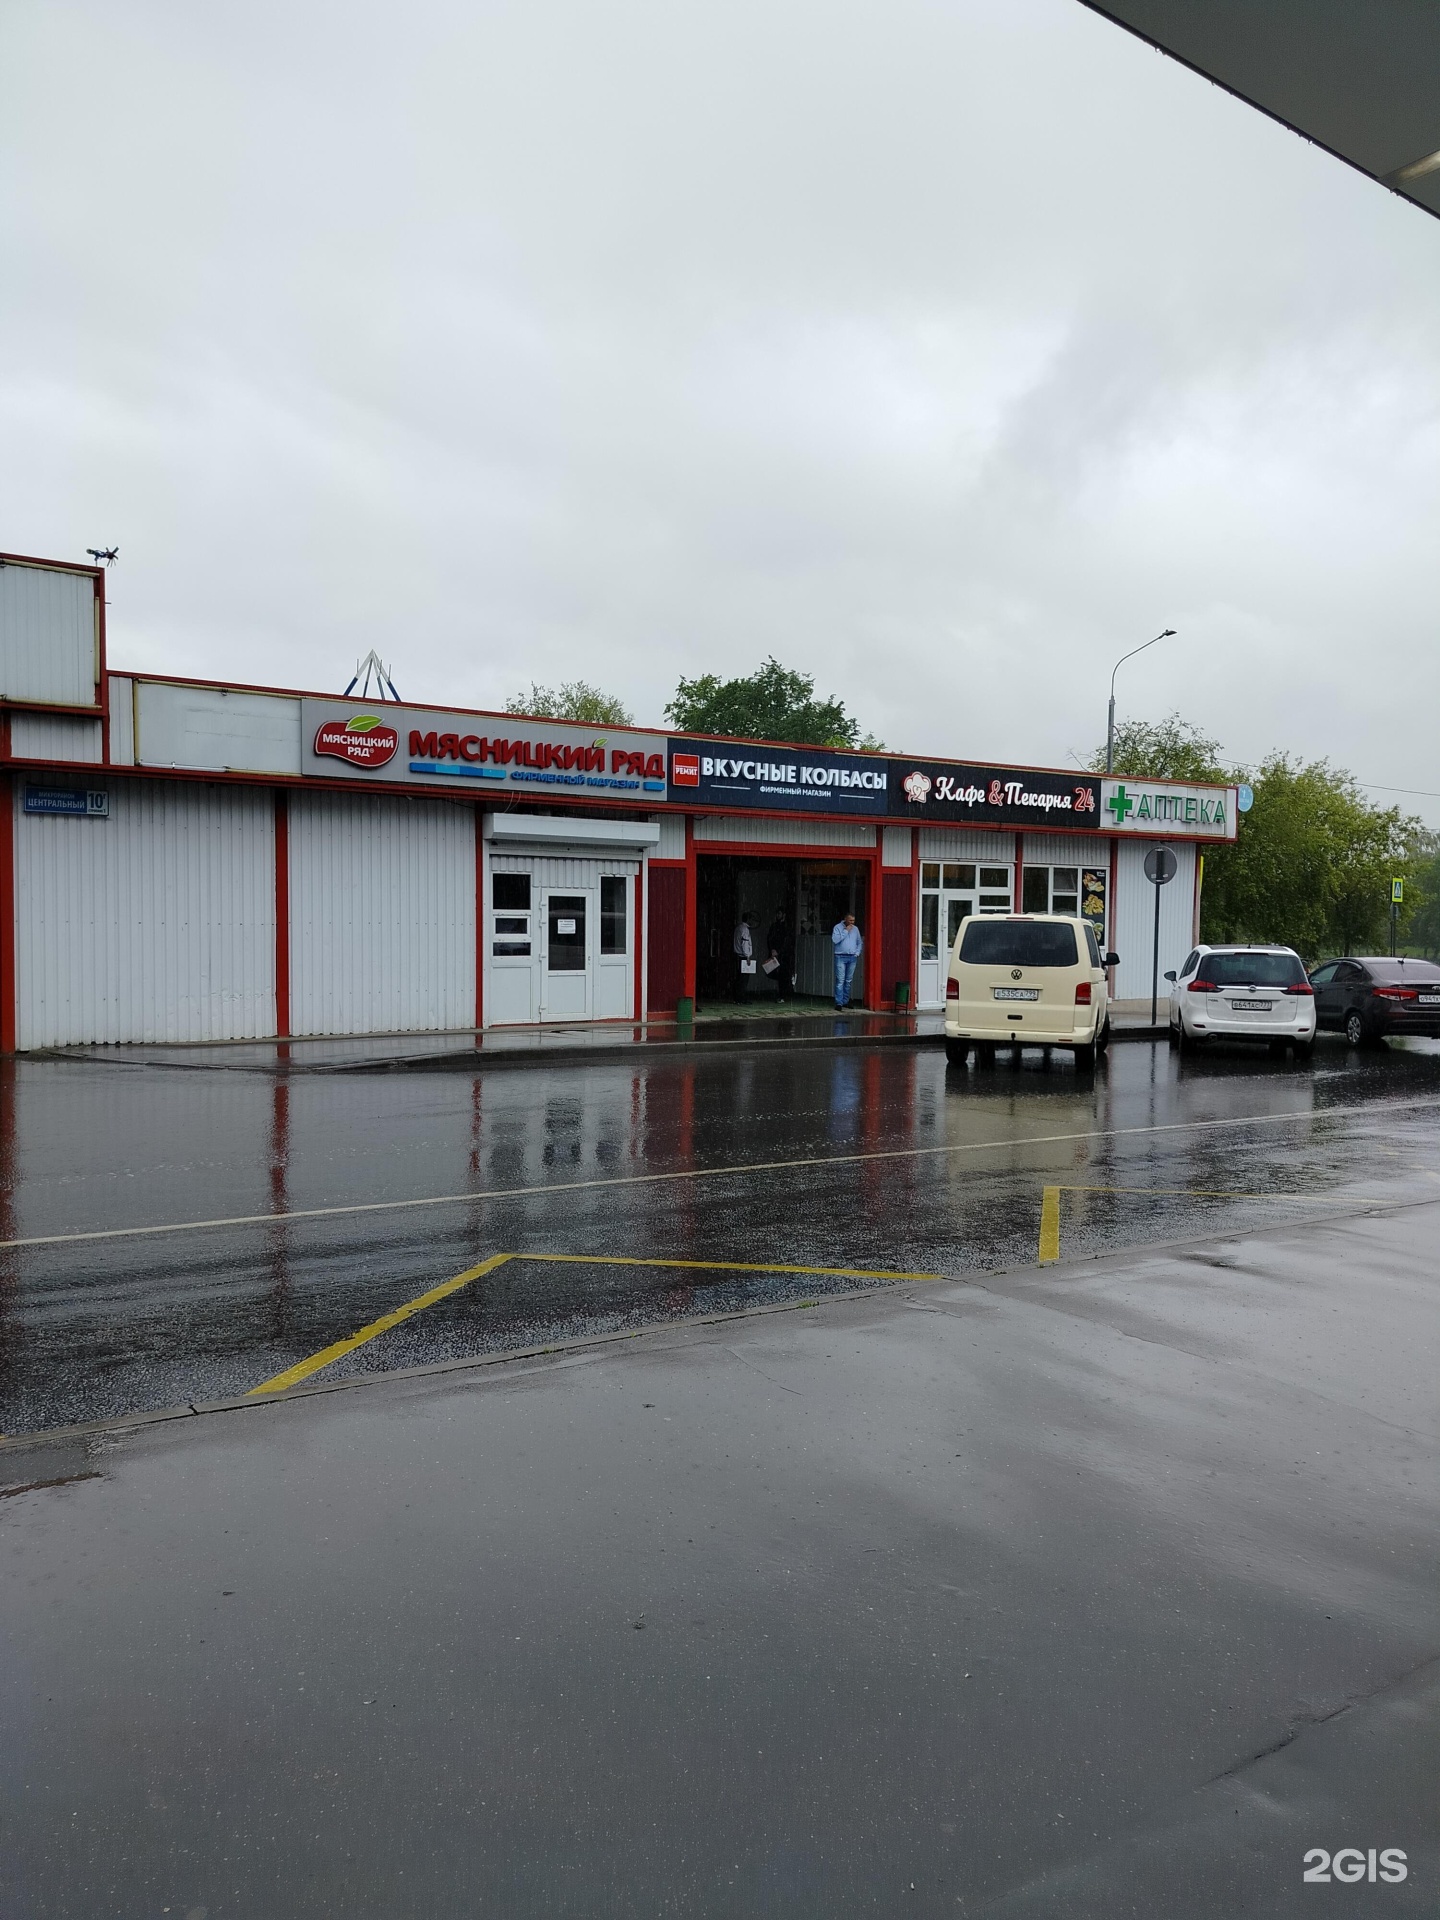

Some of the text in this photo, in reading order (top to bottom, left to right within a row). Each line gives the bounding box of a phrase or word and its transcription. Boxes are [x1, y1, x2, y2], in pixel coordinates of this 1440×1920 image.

[322, 733, 394, 749] МЯСНИЦКИЙ
[409, 730, 666, 779] МЯСНИЦКИЙ РЯД
[675, 767, 699, 776] РЕМИТ
[701, 757, 887, 790] ВКУСНЫЕ КОЛБАСЫ
[510, 771, 640, 790] ФИРМЕННЫЙ МАГАЗИН
[38, 791, 75, 799] МИКРОРАЙОН
[759, 786, 831, 798] ФИРМЕННЫЙ МАГАЗИН
[935, 776, 1095, 813] Кафе & Пекарня 24
[28, 798, 85, 809] ЦЕНТРАЛЬНЫЙ
[1136, 793, 1226, 824] АПТЕКА
